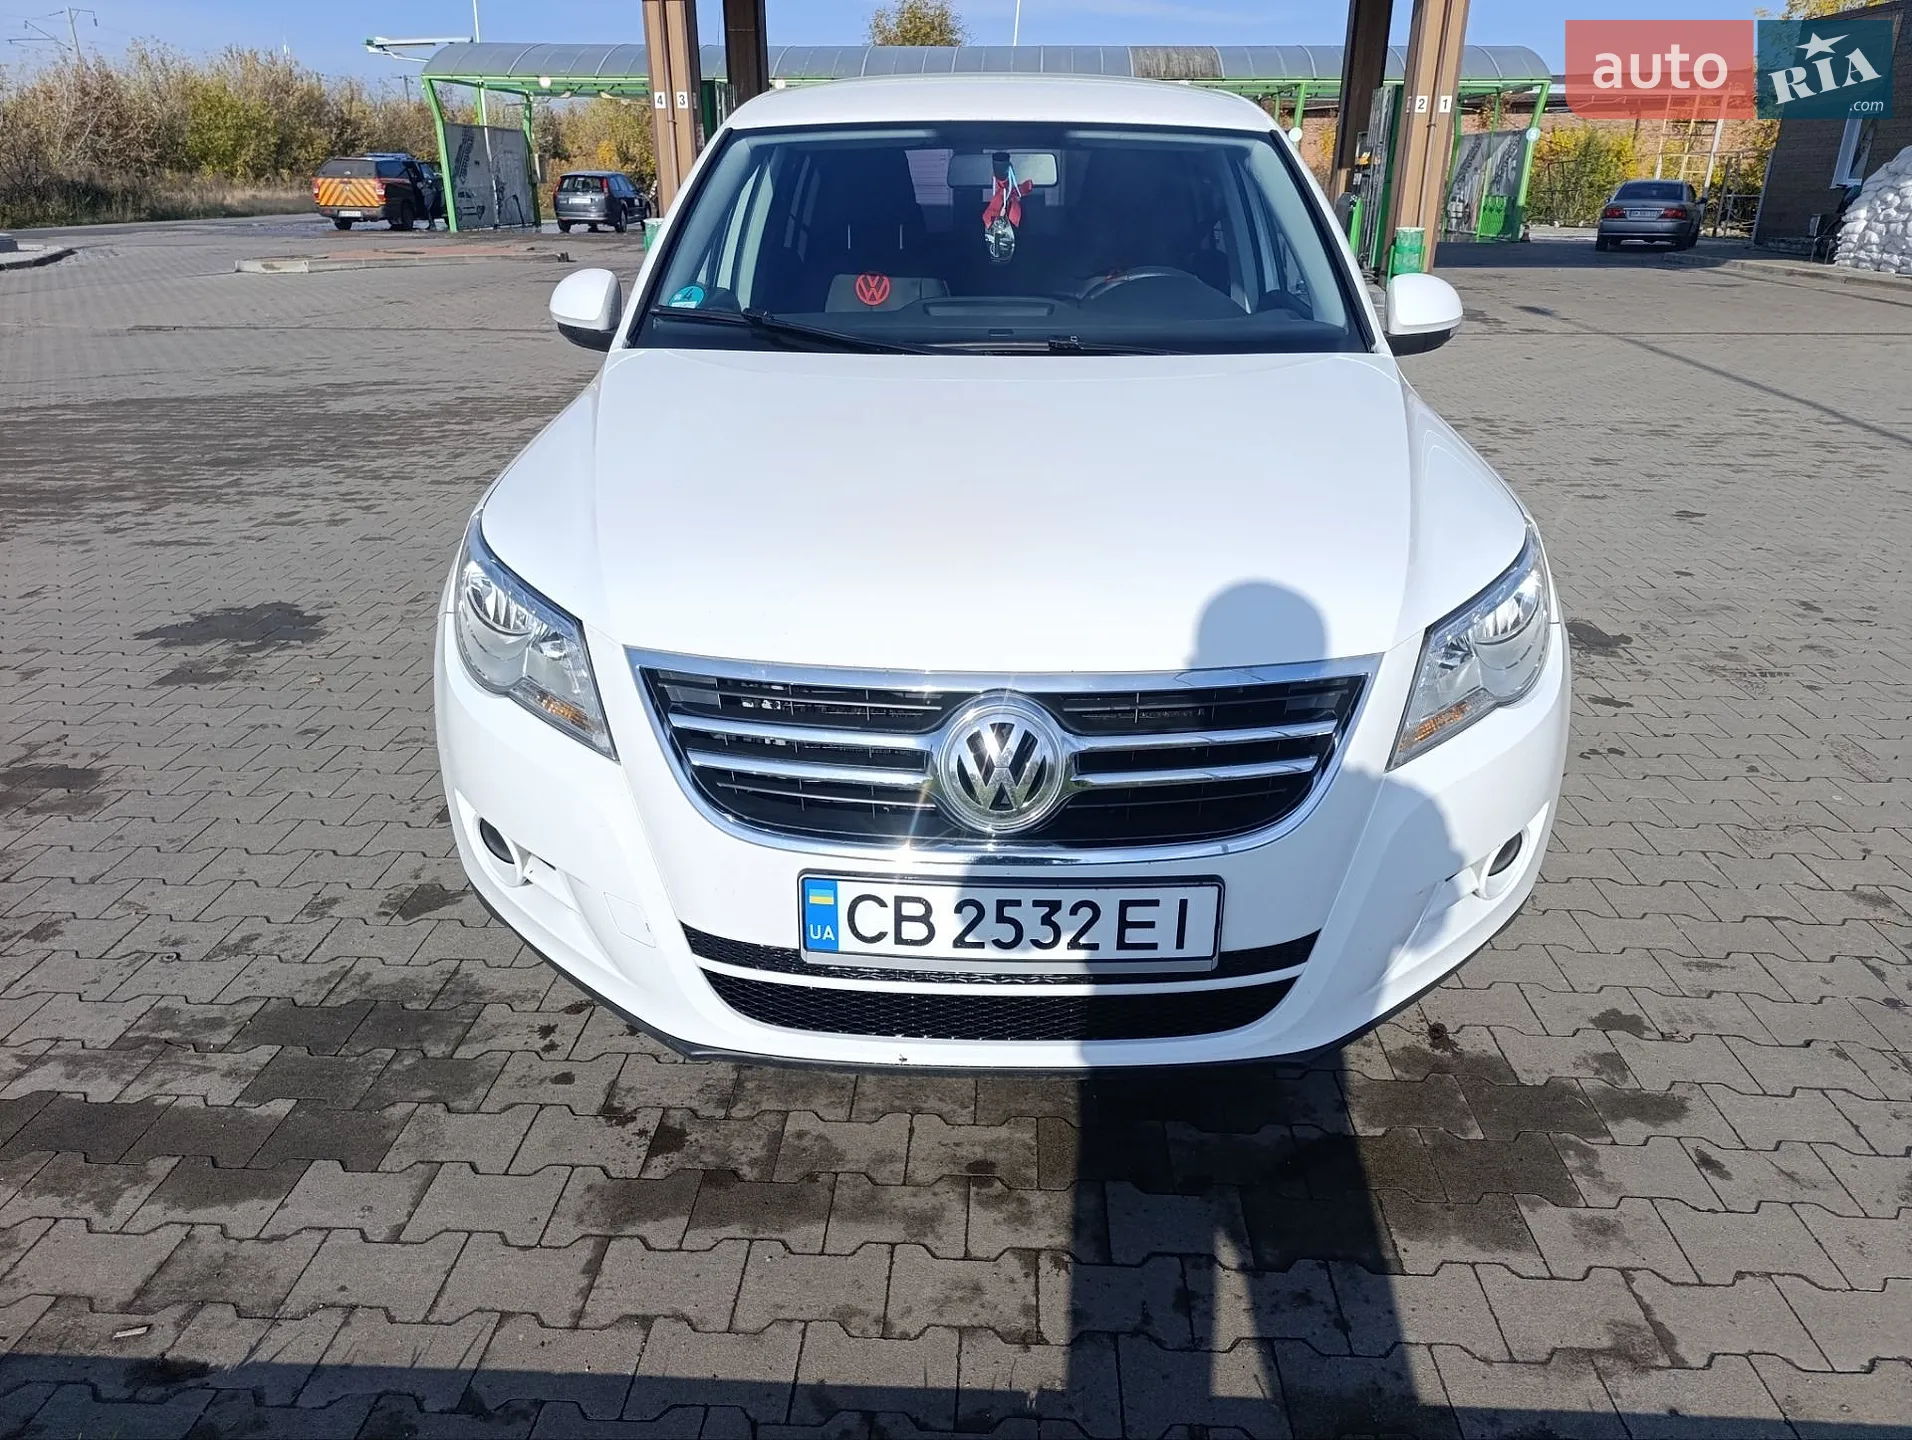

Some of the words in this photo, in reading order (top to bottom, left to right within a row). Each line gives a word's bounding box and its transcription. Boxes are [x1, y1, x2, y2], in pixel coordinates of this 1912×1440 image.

[656, 94, 664, 106] 4
[679, 94, 686, 105] 3
[1418, 98, 1426, 110] 2
[1442, 98, 1449, 110] 1
[856, 274, 890, 306] VW
[952, 718, 1051, 815] VW
[846, 892, 937, 947] CB
[951, 898, 1102, 951] 2532
[1115, 898, 1189, 951] EI
[809, 923, 836, 942] UA
